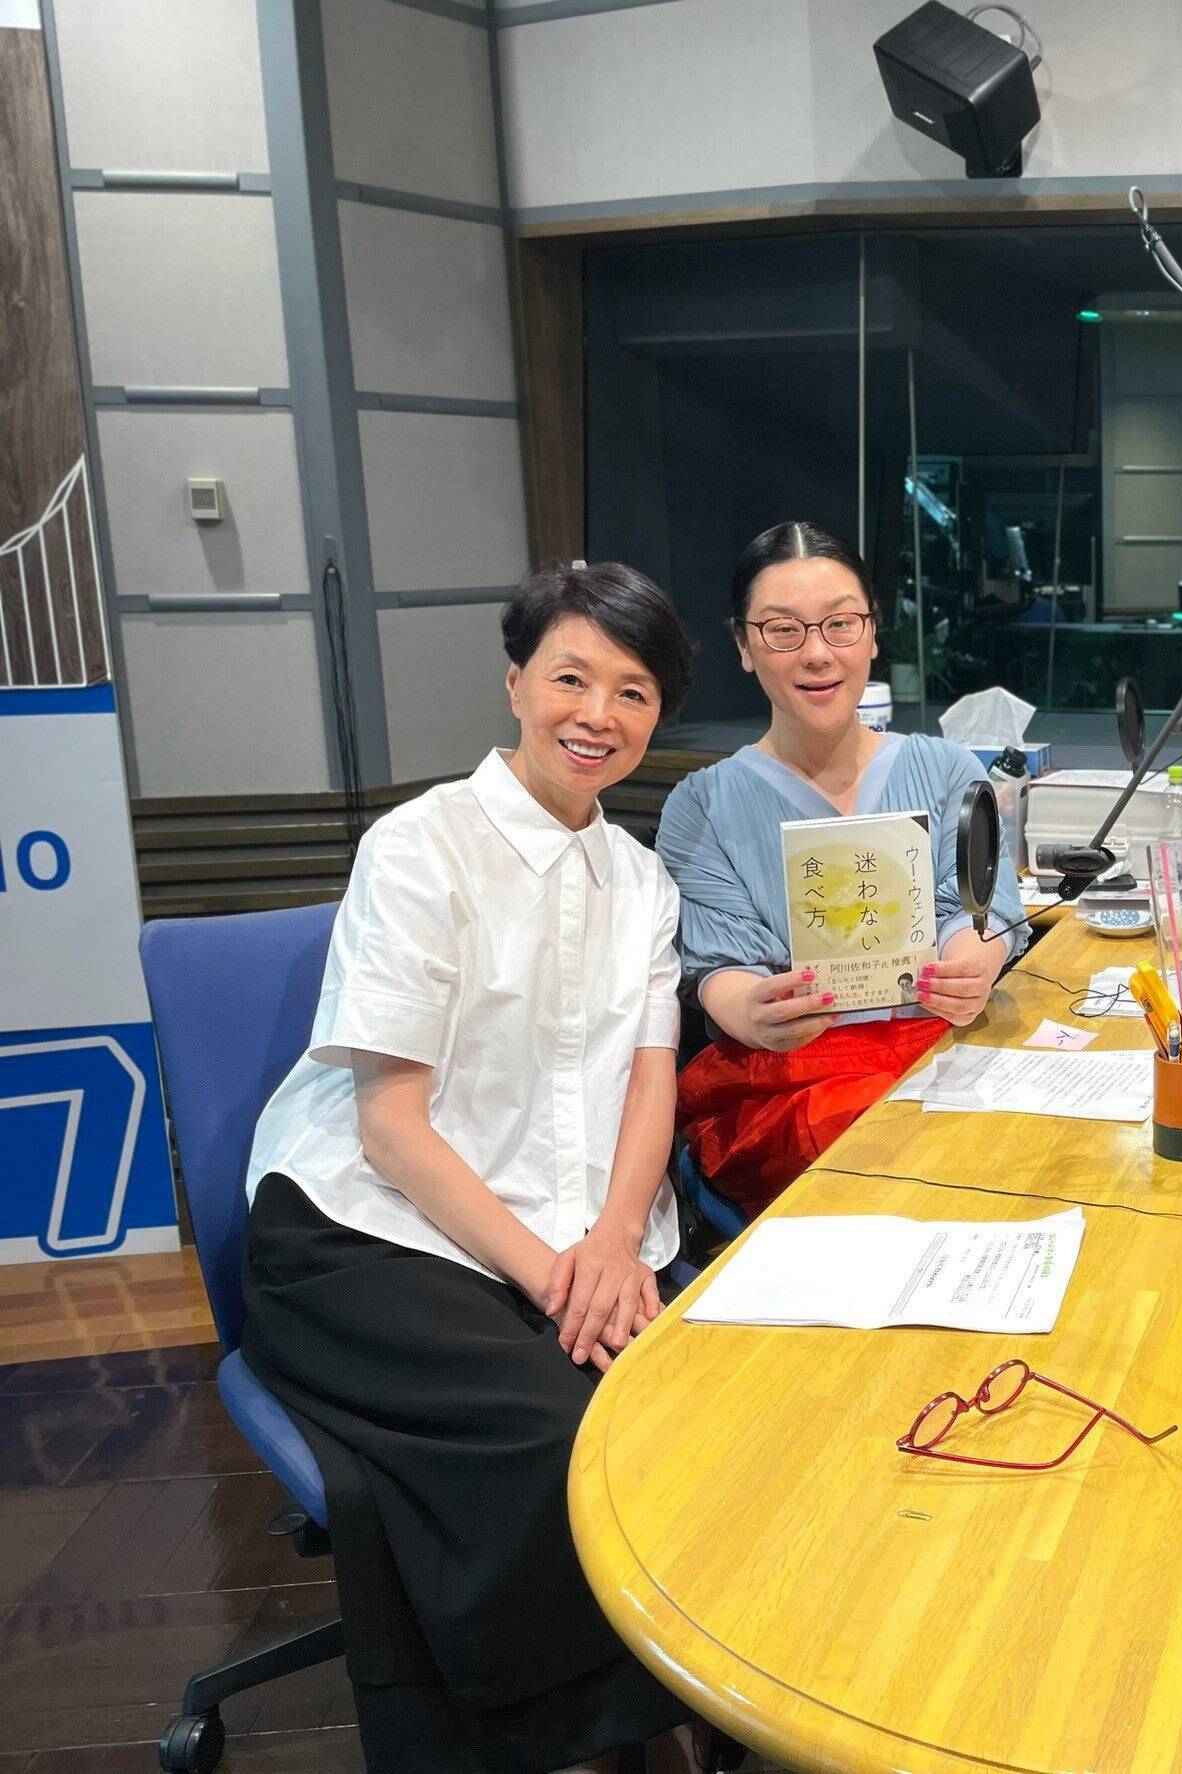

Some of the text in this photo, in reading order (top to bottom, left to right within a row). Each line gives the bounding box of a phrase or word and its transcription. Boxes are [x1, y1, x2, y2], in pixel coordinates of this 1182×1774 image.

[801, 856, 827, 929] 食べ方
[854, 851, 881, 951] 迷わない
[905, 846, 925, 944] ウー・ウェンの
